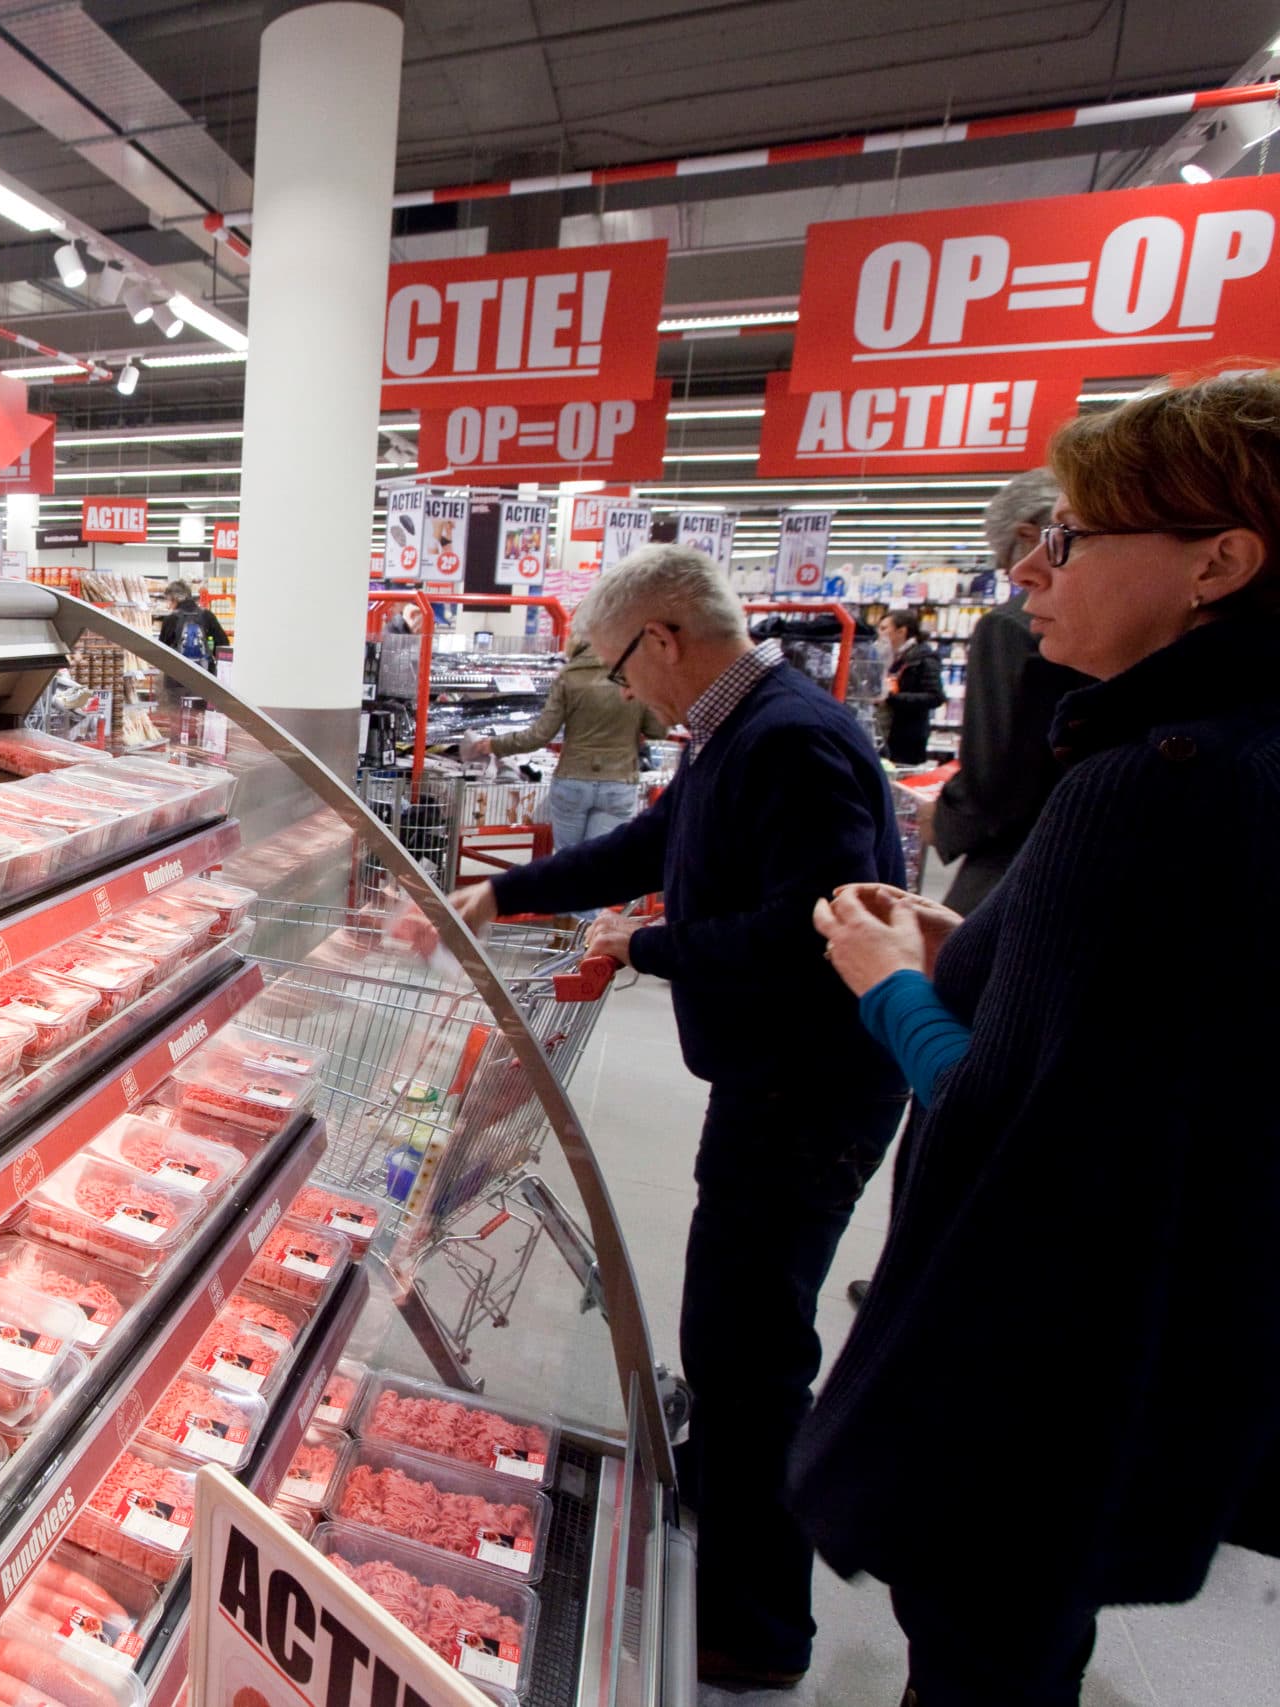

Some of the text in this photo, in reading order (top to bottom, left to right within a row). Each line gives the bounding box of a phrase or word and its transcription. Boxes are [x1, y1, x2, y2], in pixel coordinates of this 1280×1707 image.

[852, 208, 1276, 351] OP=OP
[385, 269, 611, 376] CTIE!
[797, 379, 1037, 452] ACTIE!
[445, 400, 636, 465] OP=OP
[392, 490, 422, 512] ACTIE!
[425, 500, 464, 519] ACTIE!
[86, 505, 145, 529] ACTIE!
[505, 505, 546, 523] ACTIE!
[609, 511, 648, 529] ACTIE!
[682, 515, 720, 534] ACTIE!
[785, 515, 826, 534] ACTIE!
[0, 1487, 76, 1599] Rundvlees
[219, 1524, 432, 1707] ACT
